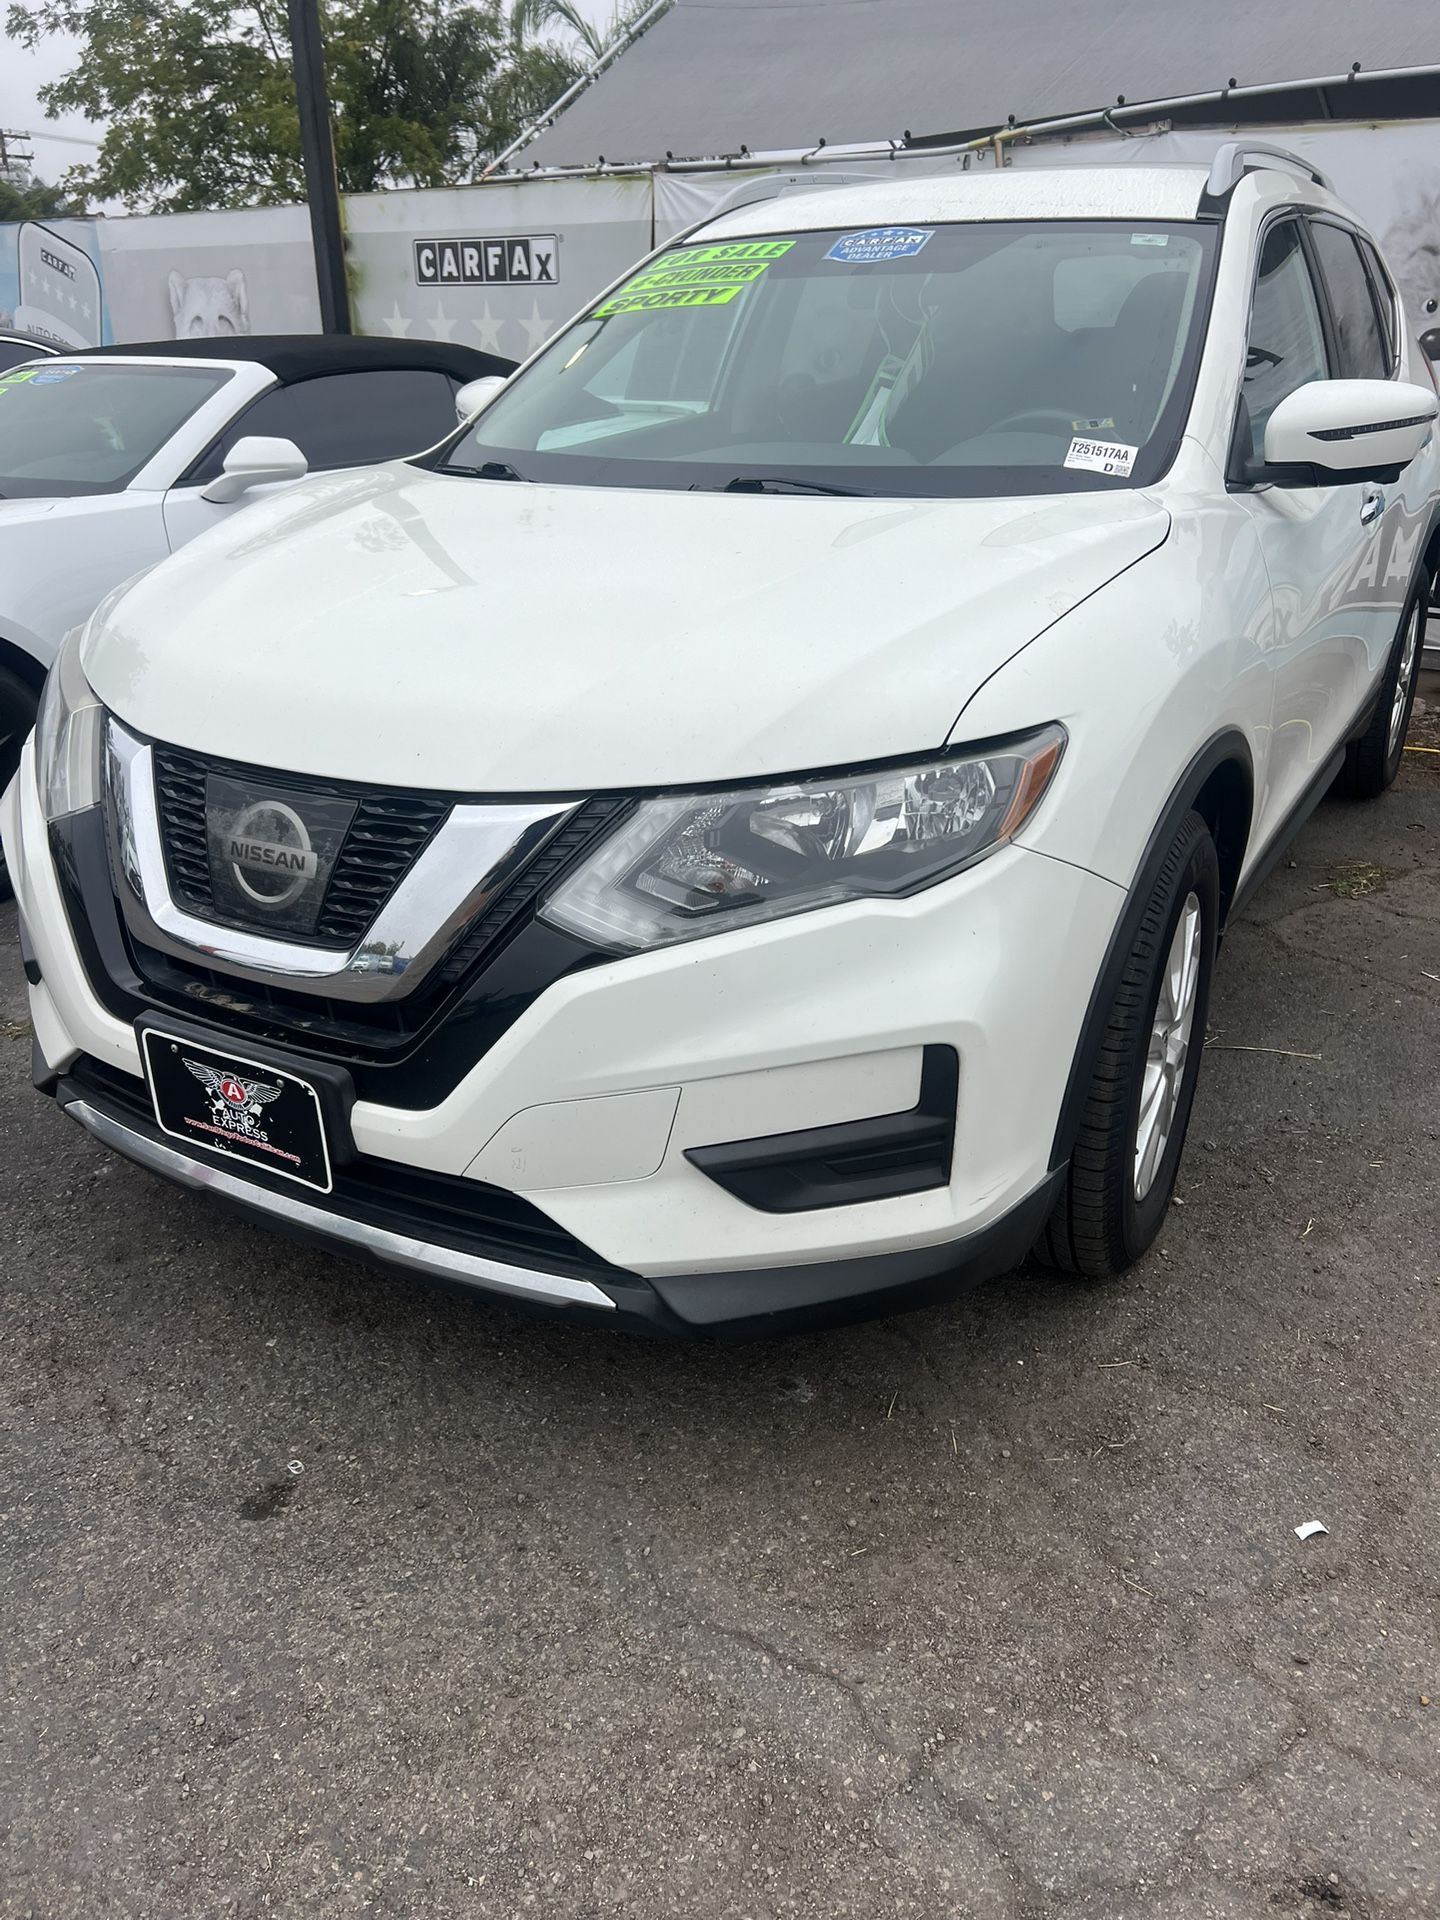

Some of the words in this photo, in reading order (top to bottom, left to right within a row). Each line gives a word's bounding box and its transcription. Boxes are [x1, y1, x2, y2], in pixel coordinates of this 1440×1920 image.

[841, 245, 909, 254] ADVANTAGE
[844, 235, 923, 247] CARFAX
[41, 248, 77, 282] CARFAX
[417, 242, 555, 282] CARFAX
[651, 251, 709, 269] FOR
[712, 243, 790, 259] SALE
[847, 252, 892, 260] DEALER
[603, 287, 730, 313] SPORTY
[1071, 442, 1129, 461] T251517AA
[1104, 463, 1114, 472] D
[230, 841, 306, 871] NISSAN
[227, 1083, 242, 1100] A
[222, 1108, 255, 1125] AUTO
[212, 1115, 269, 1142] EXPRESS
